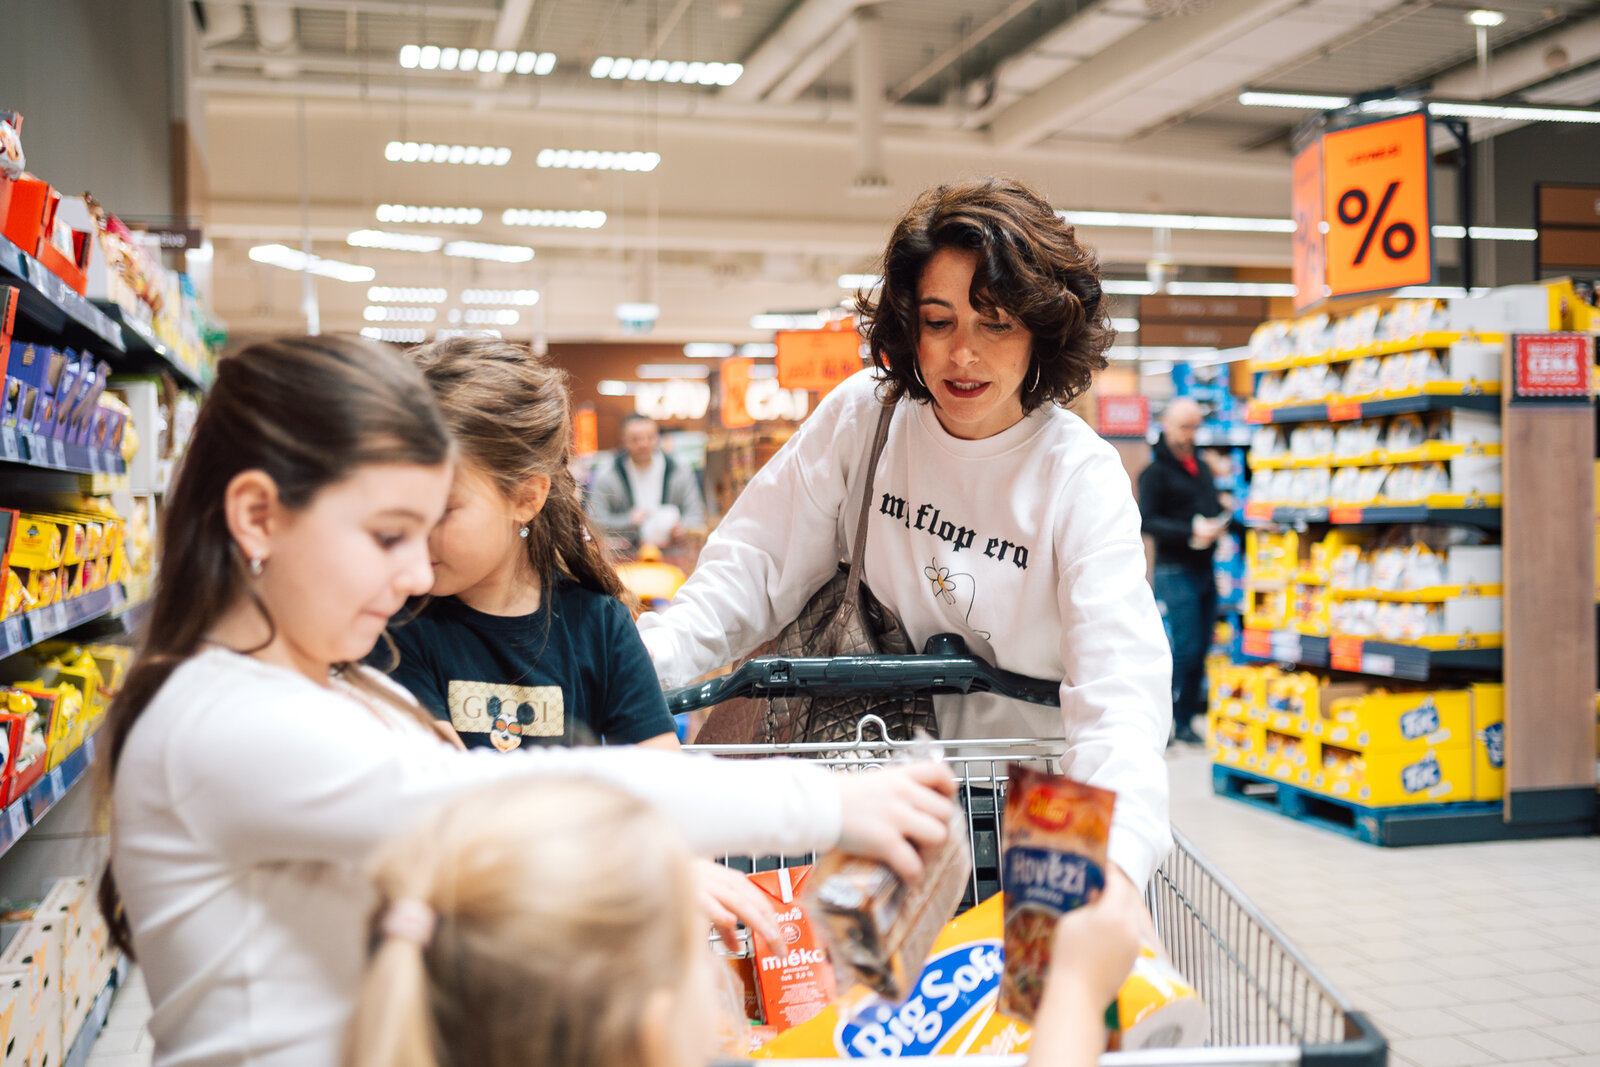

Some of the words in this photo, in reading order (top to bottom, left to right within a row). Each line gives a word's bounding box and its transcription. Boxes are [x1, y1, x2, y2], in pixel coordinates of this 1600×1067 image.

[1338, 181, 1416, 266] %
[914, 503, 976, 552] flop
[984, 537, 1029, 570] era
